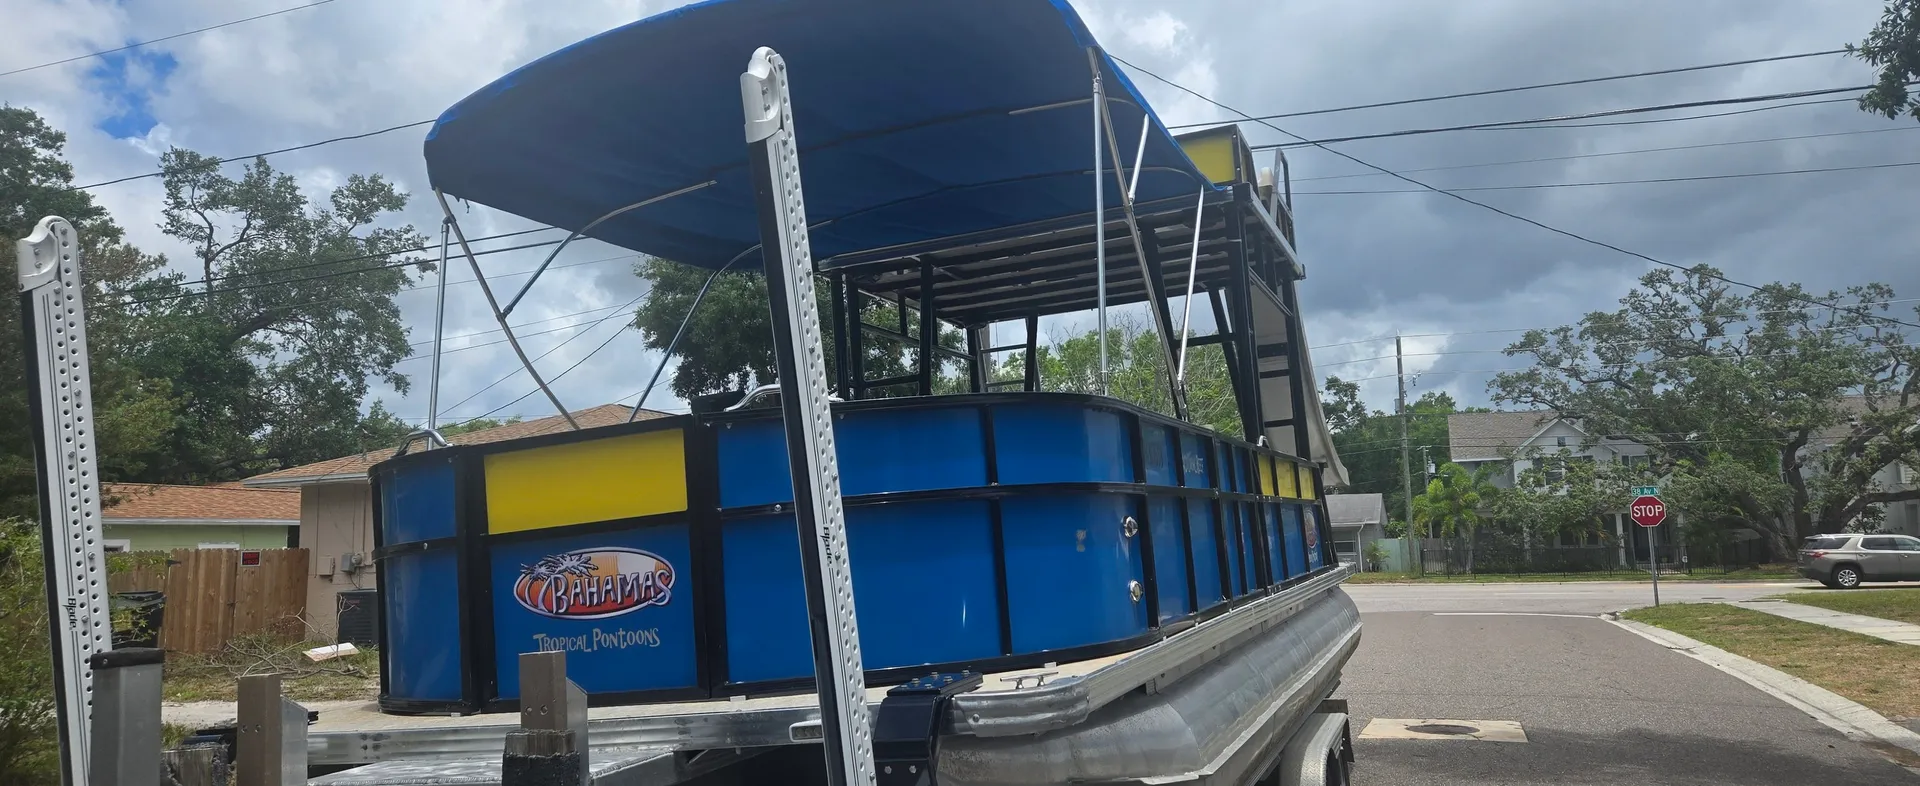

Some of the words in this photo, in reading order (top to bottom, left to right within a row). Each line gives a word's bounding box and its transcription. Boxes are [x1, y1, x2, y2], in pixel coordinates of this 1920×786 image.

[1633, 505, 1663, 517] STOP
[550, 569, 672, 614] BAHAMAS
[62, 598, 78, 629] Blade
[533, 633, 592, 653] TROPICAL
